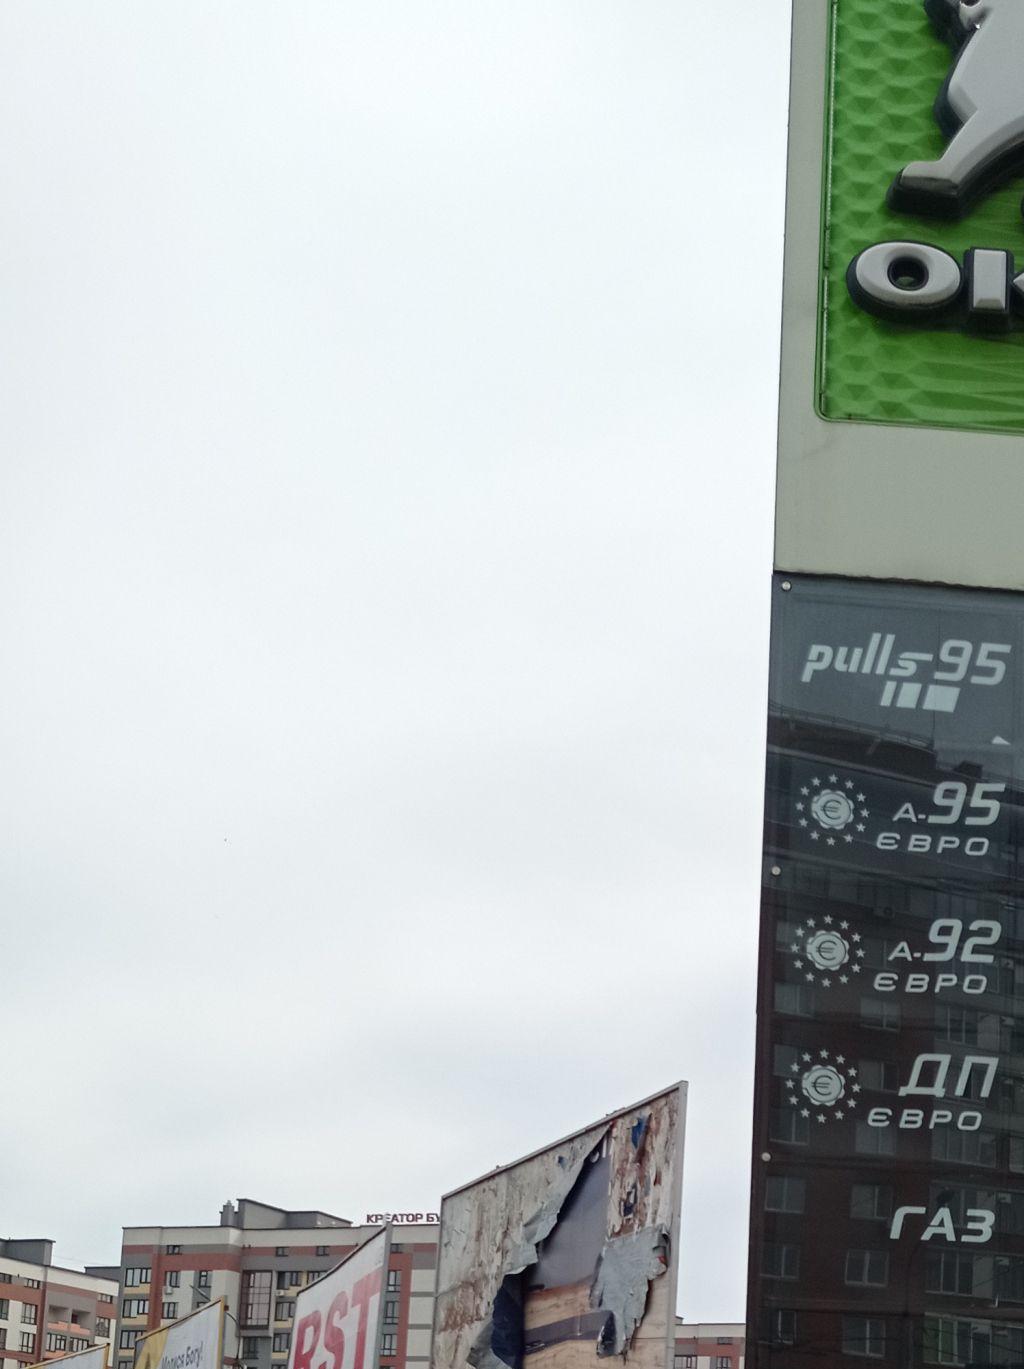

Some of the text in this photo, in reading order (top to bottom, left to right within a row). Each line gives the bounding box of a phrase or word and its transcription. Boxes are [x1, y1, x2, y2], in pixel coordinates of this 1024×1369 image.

[802, 633, 1012, 686] pulls 95
[893, 780, 1006, 826] А-95
[876, 833, 990, 857] ЄВРО
[889, 919, 1003, 964] А-92
[873, 973, 988, 994] ЄВРО
[899, 1053, 999, 1098] ДП
[867, 1108, 983, 1130] ЄВРО
[889, 1206, 996, 1242] ГАЗ
